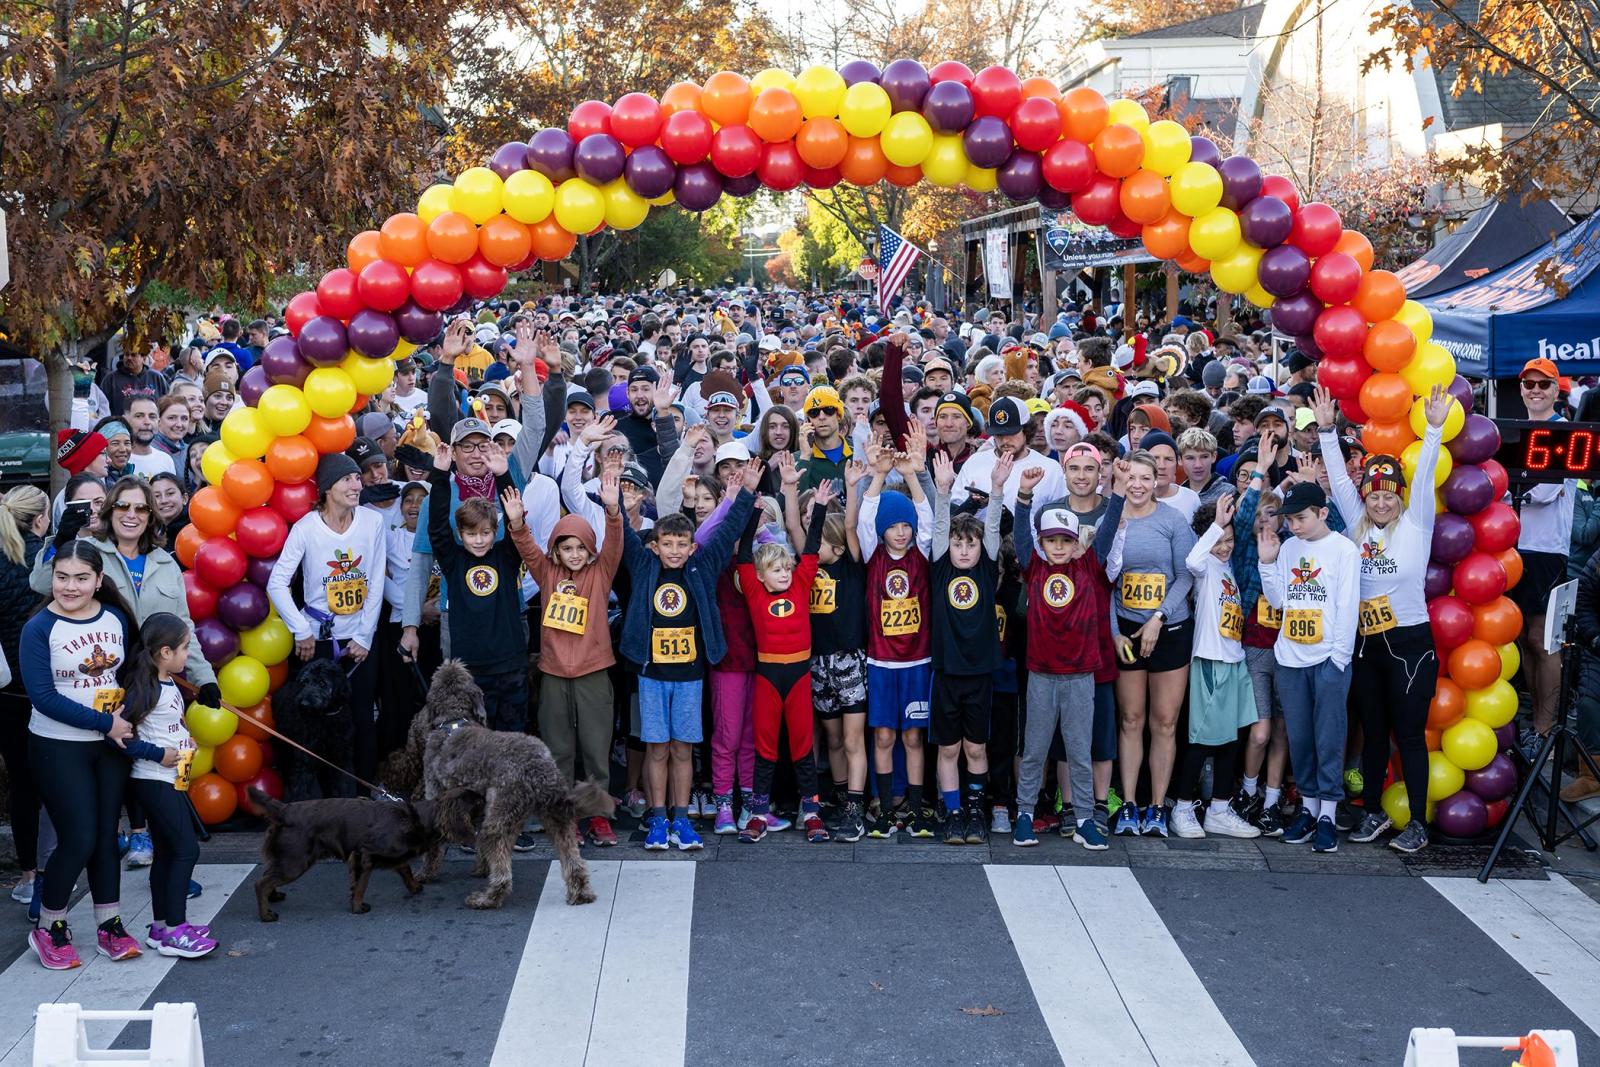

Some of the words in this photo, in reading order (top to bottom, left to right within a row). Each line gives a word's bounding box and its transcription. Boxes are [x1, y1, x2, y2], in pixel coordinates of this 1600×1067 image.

[1063, 253, 1087, 261] Unless
[1088, 253, 1101, 261] you
[860, 264, 878, 273] STOP
[1377, 565, 1398, 575] TROT
[334, 588, 363, 608] 366
[1123, 583, 1164, 602] 2464
[1310, 593, 1327, 603] TROT
[548, 603, 585, 626] 1101
[883, 607, 920, 628] 2223
[1289, 619, 1316, 637] 896
[62, 631, 122, 655] THANKFUL
[660, 638, 691, 655] 513
[56, 669, 75, 679] FOR
[168, 723, 180, 733] FOR
